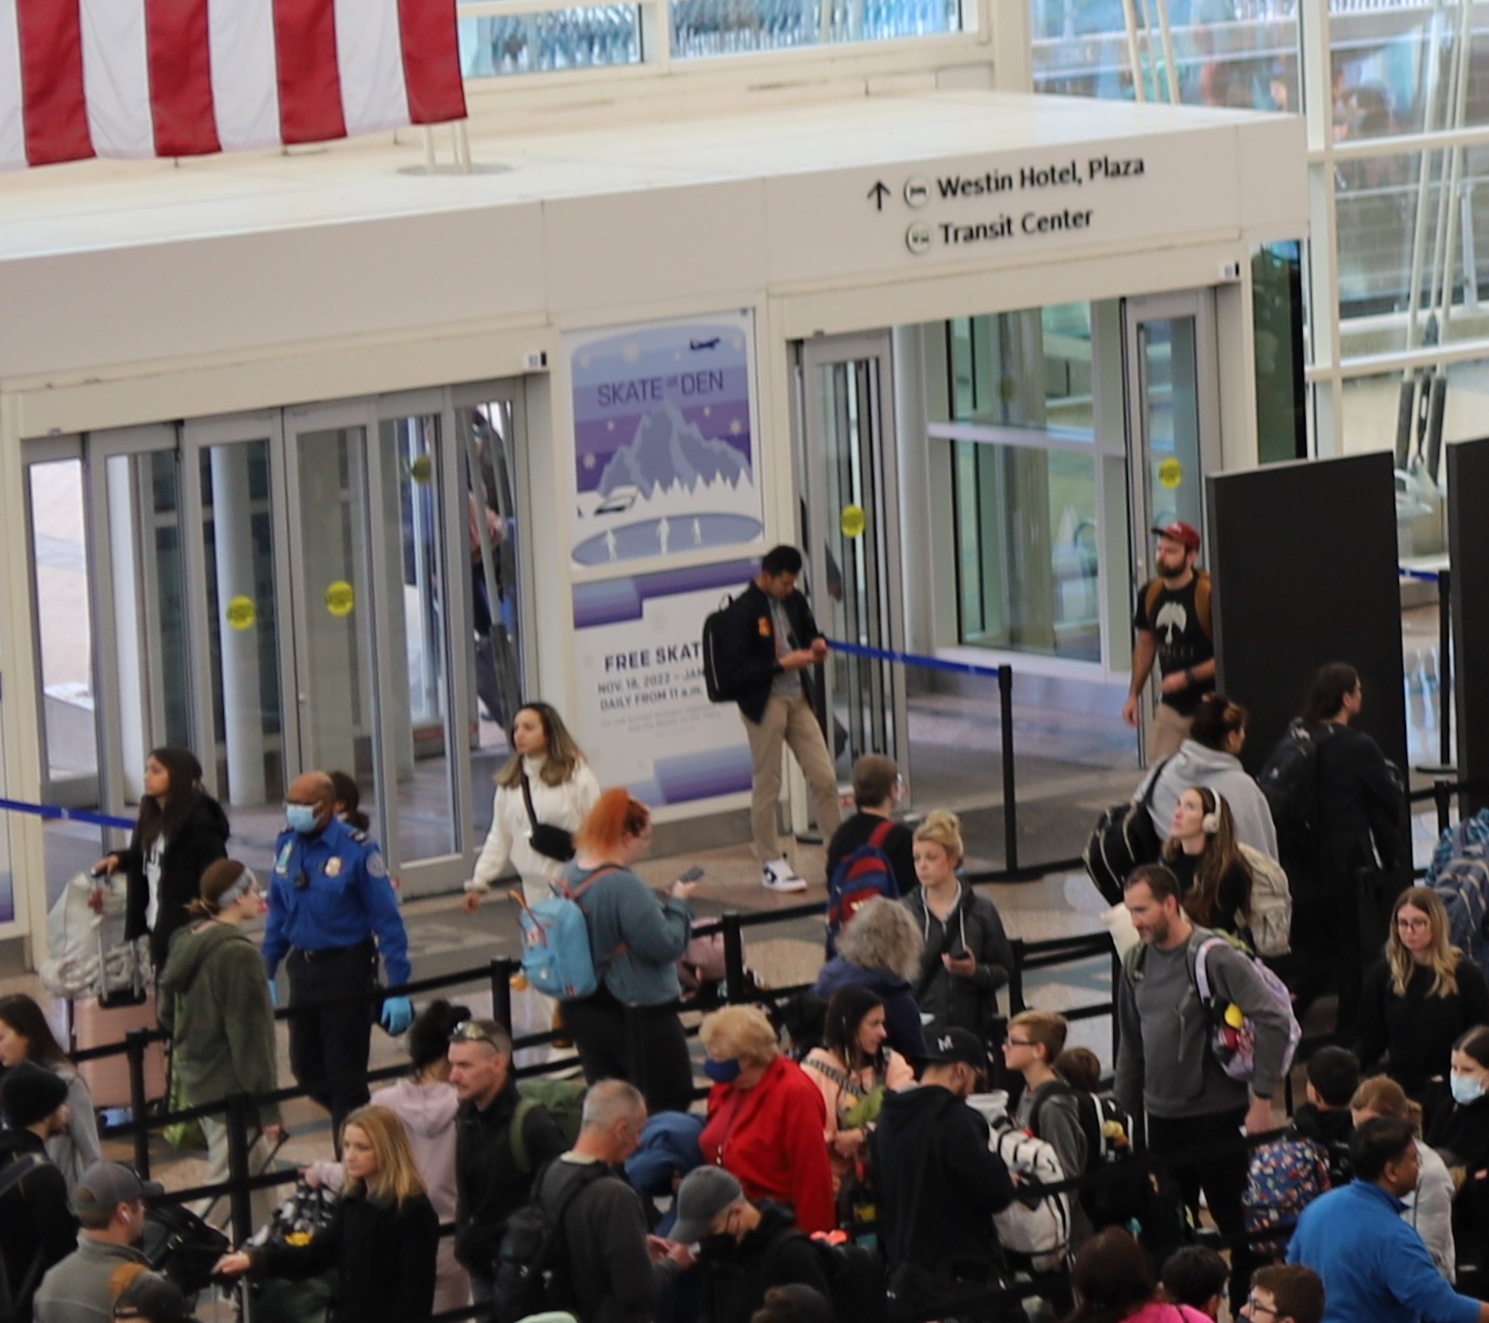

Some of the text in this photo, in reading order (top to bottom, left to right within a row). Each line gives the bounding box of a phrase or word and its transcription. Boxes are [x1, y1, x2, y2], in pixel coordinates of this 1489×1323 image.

[937, 156, 1145, 199] Westin Hotel, Plaza
[939, 208, 1093, 245] Transit Center
[597, 376, 663, 407] SKATE
[681, 370, 724, 396] DEN
[605, 650, 650, 673] FREE
[644, 672, 670, 688] 2022
[600, 694, 632, 711] DAILY
[635, 689, 666, 705] FROM
